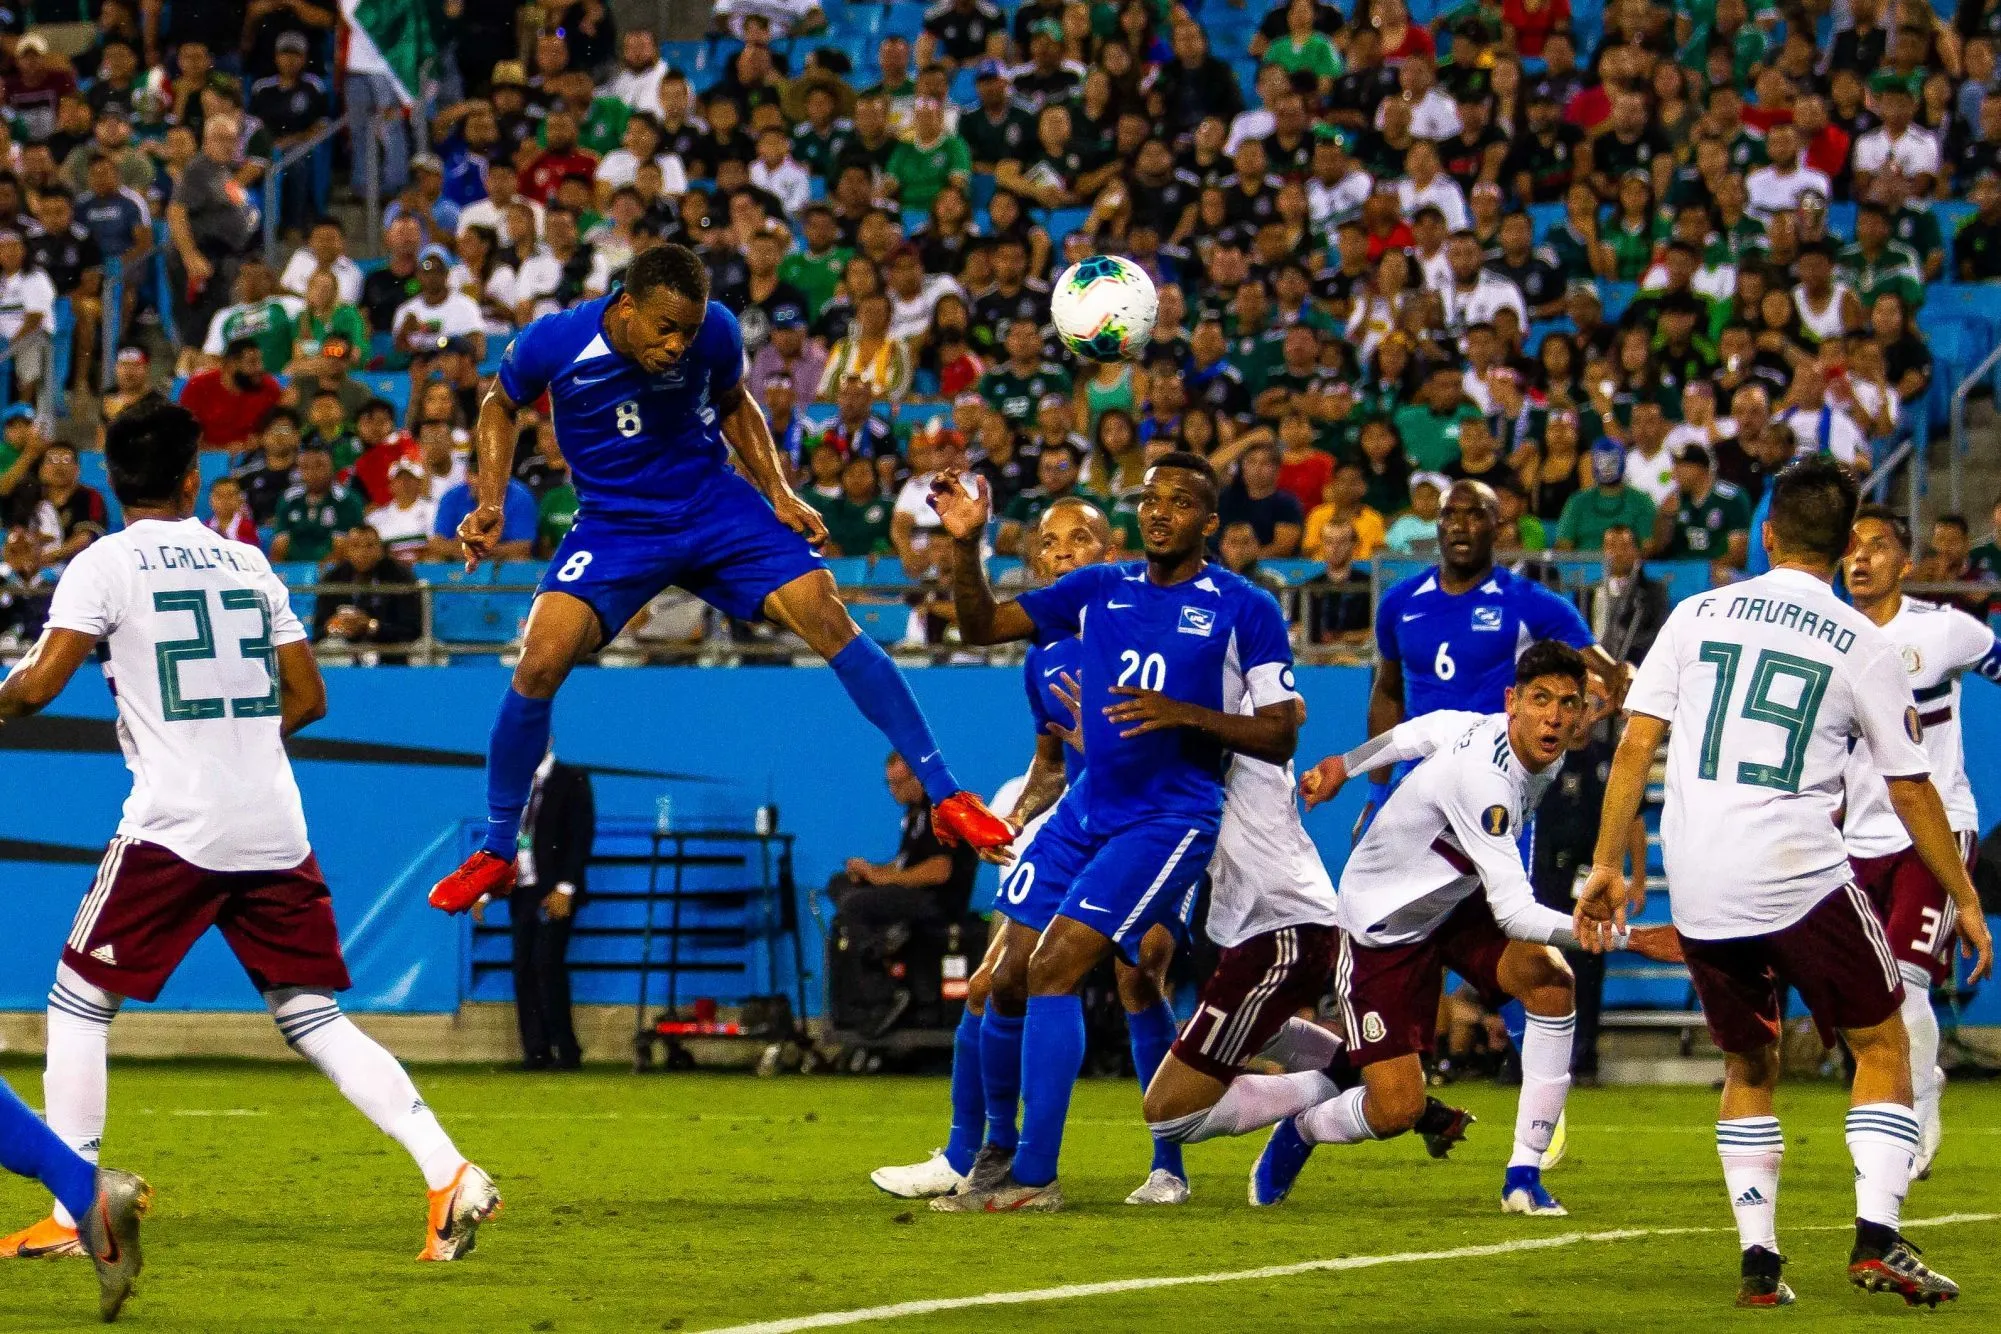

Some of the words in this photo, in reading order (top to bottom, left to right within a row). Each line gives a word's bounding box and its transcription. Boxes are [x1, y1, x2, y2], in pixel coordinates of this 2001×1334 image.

[616, 401, 642, 438] 8
[557, 551, 593, 582] 8
[1696, 598, 1716, 617] F.
[1727, 597, 1856, 654] NAVARRO
[152, 588, 281, 721] 23
[1117, 649, 1167, 692] 20
[1435, 641, 1456, 681] 6
[1698, 641, 1834, 794] 19
[996, 861, 1035, 905] 0
[1910, 905, 1942, 955] 3
[1181, 1000, 1229, 1056] 17
